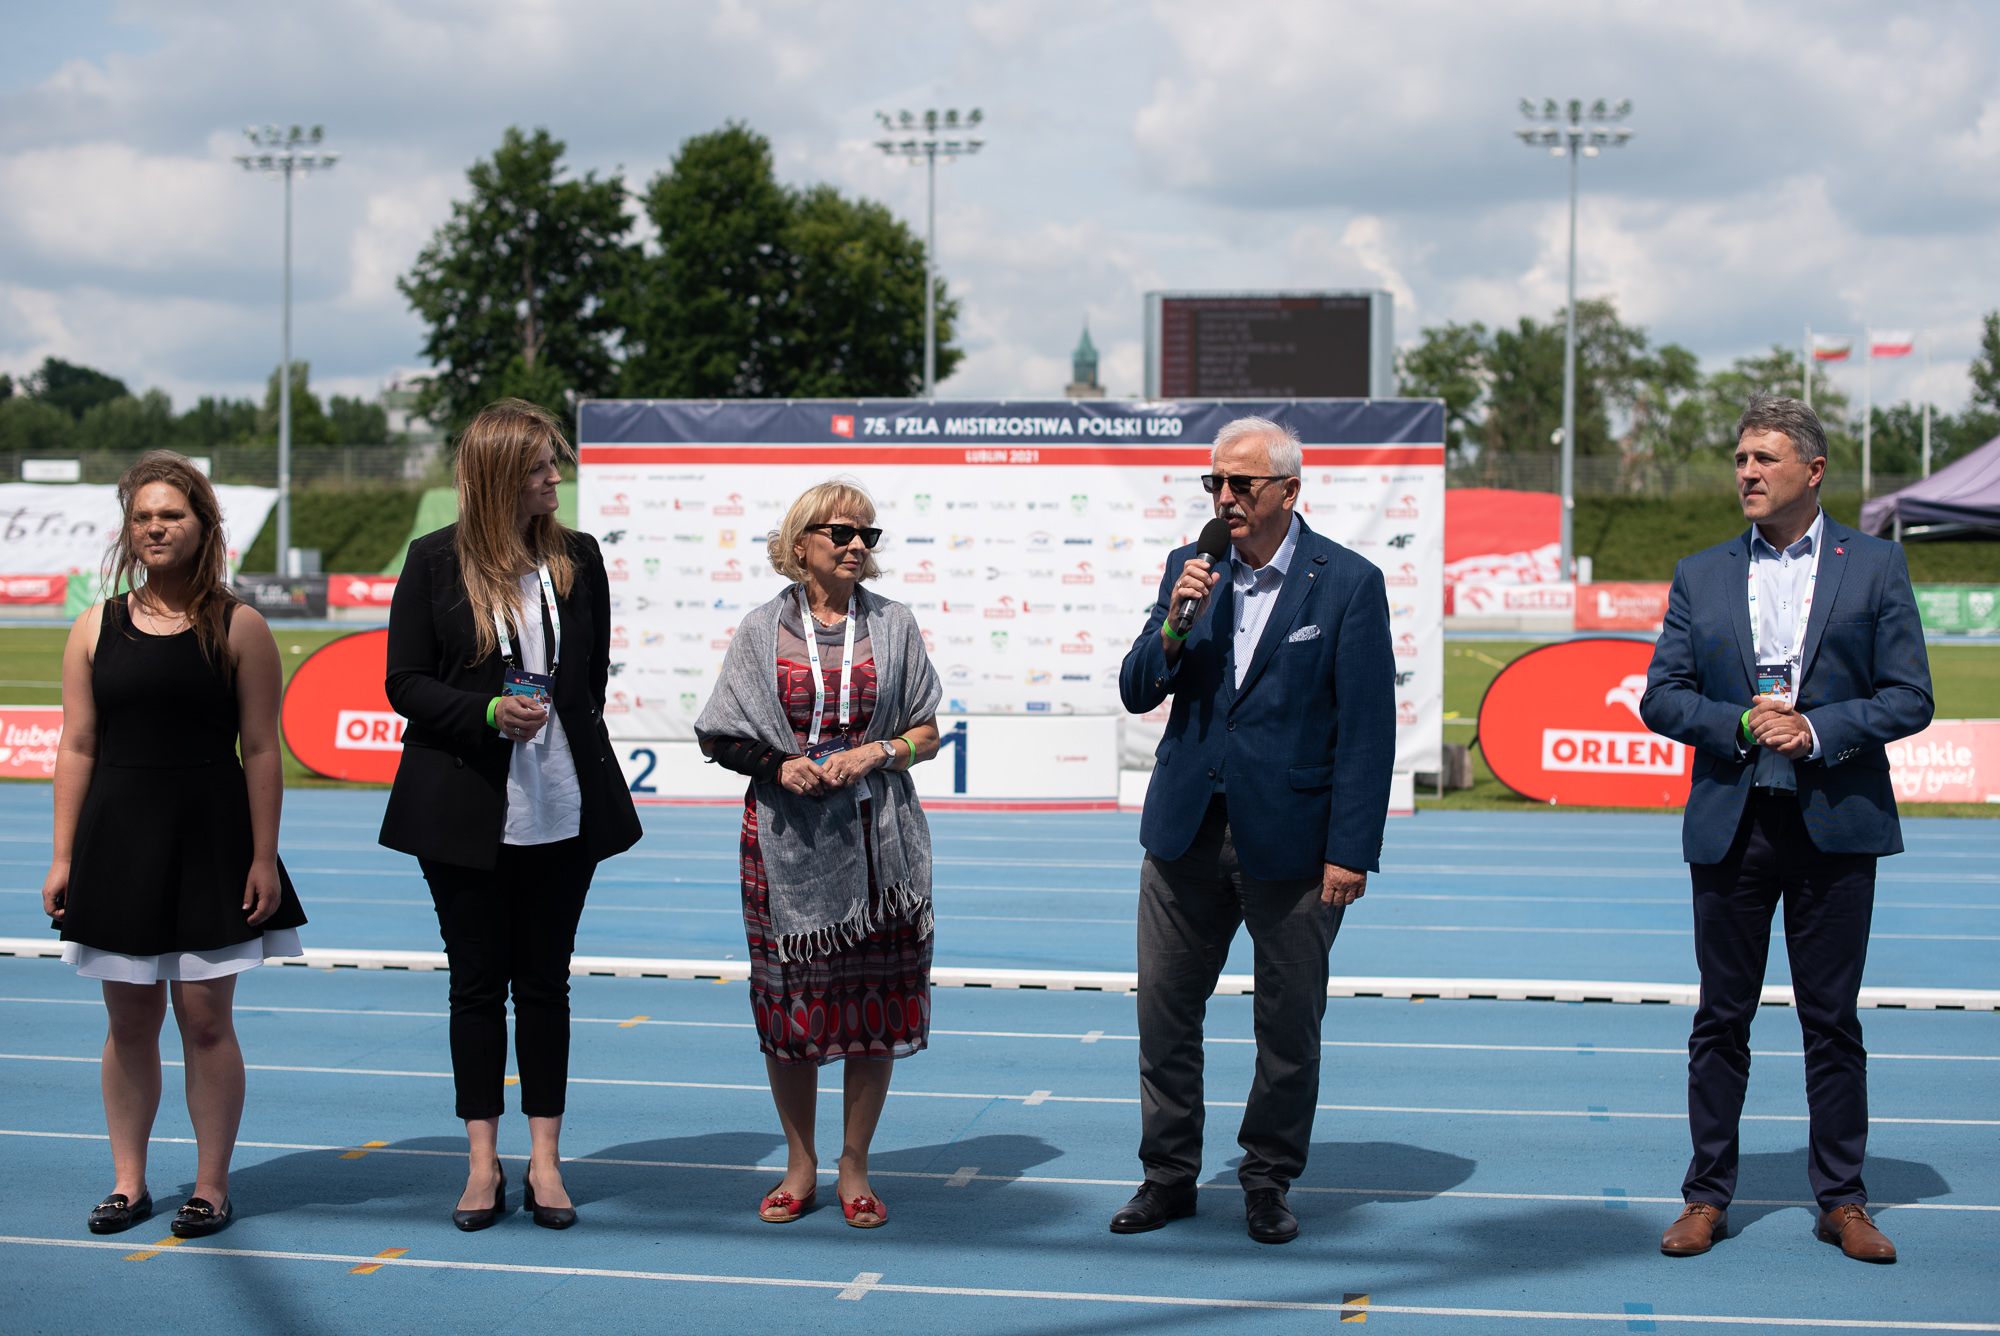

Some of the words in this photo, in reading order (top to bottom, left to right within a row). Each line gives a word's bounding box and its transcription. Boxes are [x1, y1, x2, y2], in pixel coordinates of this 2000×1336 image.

[863, 418, 890, 435] 75.
[895, 418, 940, 436] PZLA
[944, 418, 1074, 436] MISTRZOSTWA
[1077, 418, 1142, 436] POLSKI
[1146, 418, 1183, 436] U20
[965, 450, 1007, 463] LUBLIN
[1009, 450, 1040, 463] 2021
[939, 721, 967, 793] 1
[1552, 738, 1674, 766] ORLEN
[629, 748, 656, 793] 2
